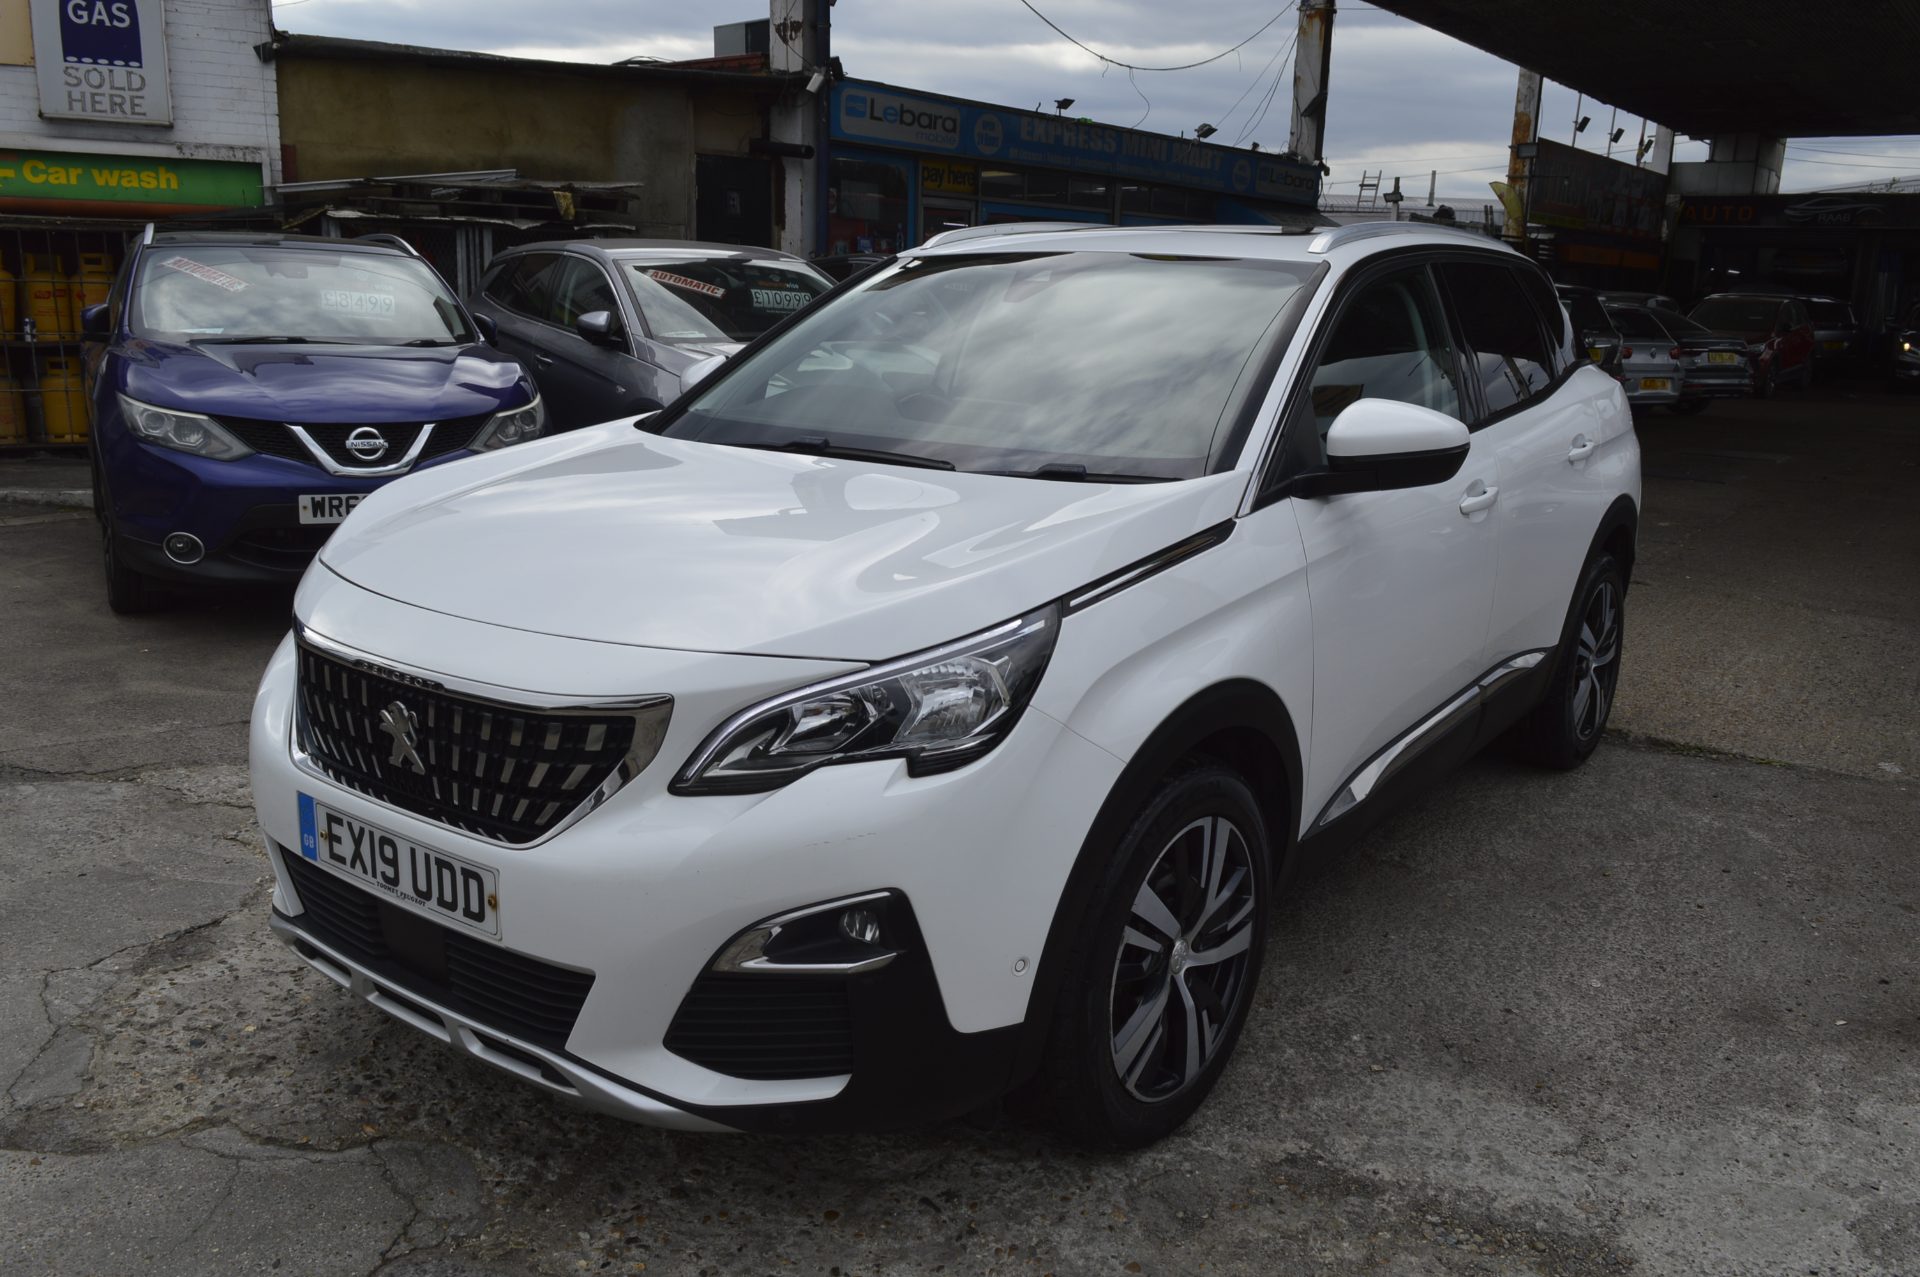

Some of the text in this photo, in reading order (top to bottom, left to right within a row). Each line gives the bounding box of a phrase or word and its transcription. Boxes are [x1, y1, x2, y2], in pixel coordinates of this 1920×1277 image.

[67, 0, 131, 28] GAS
[63, 66, 146, 93] SOLD
[67, 90, 147, 117] HERE
[869, 97, 958, 134] Lebara
[915, 129, 957, 146] mobile
[1121, 131, 1168, 163] MINI
[22, 160, 179, 190] Car wash
[922, 163, 976, 188] pay here
[1268, 168, 1314, 190] Lebara
[1684, 205, 1758, 222] AUTO
[651, 270, 720, 296] AUTOMATIC
[323, 290, 393, 313] £8499
[754, 290, 812, 307] £10999
[350, 441, 387, 449] NISSAN
[311, 496, 368, 518] WR6
[303, 833, 315, 849] GB
[326, 813, 485, 923] EX19 UDD
